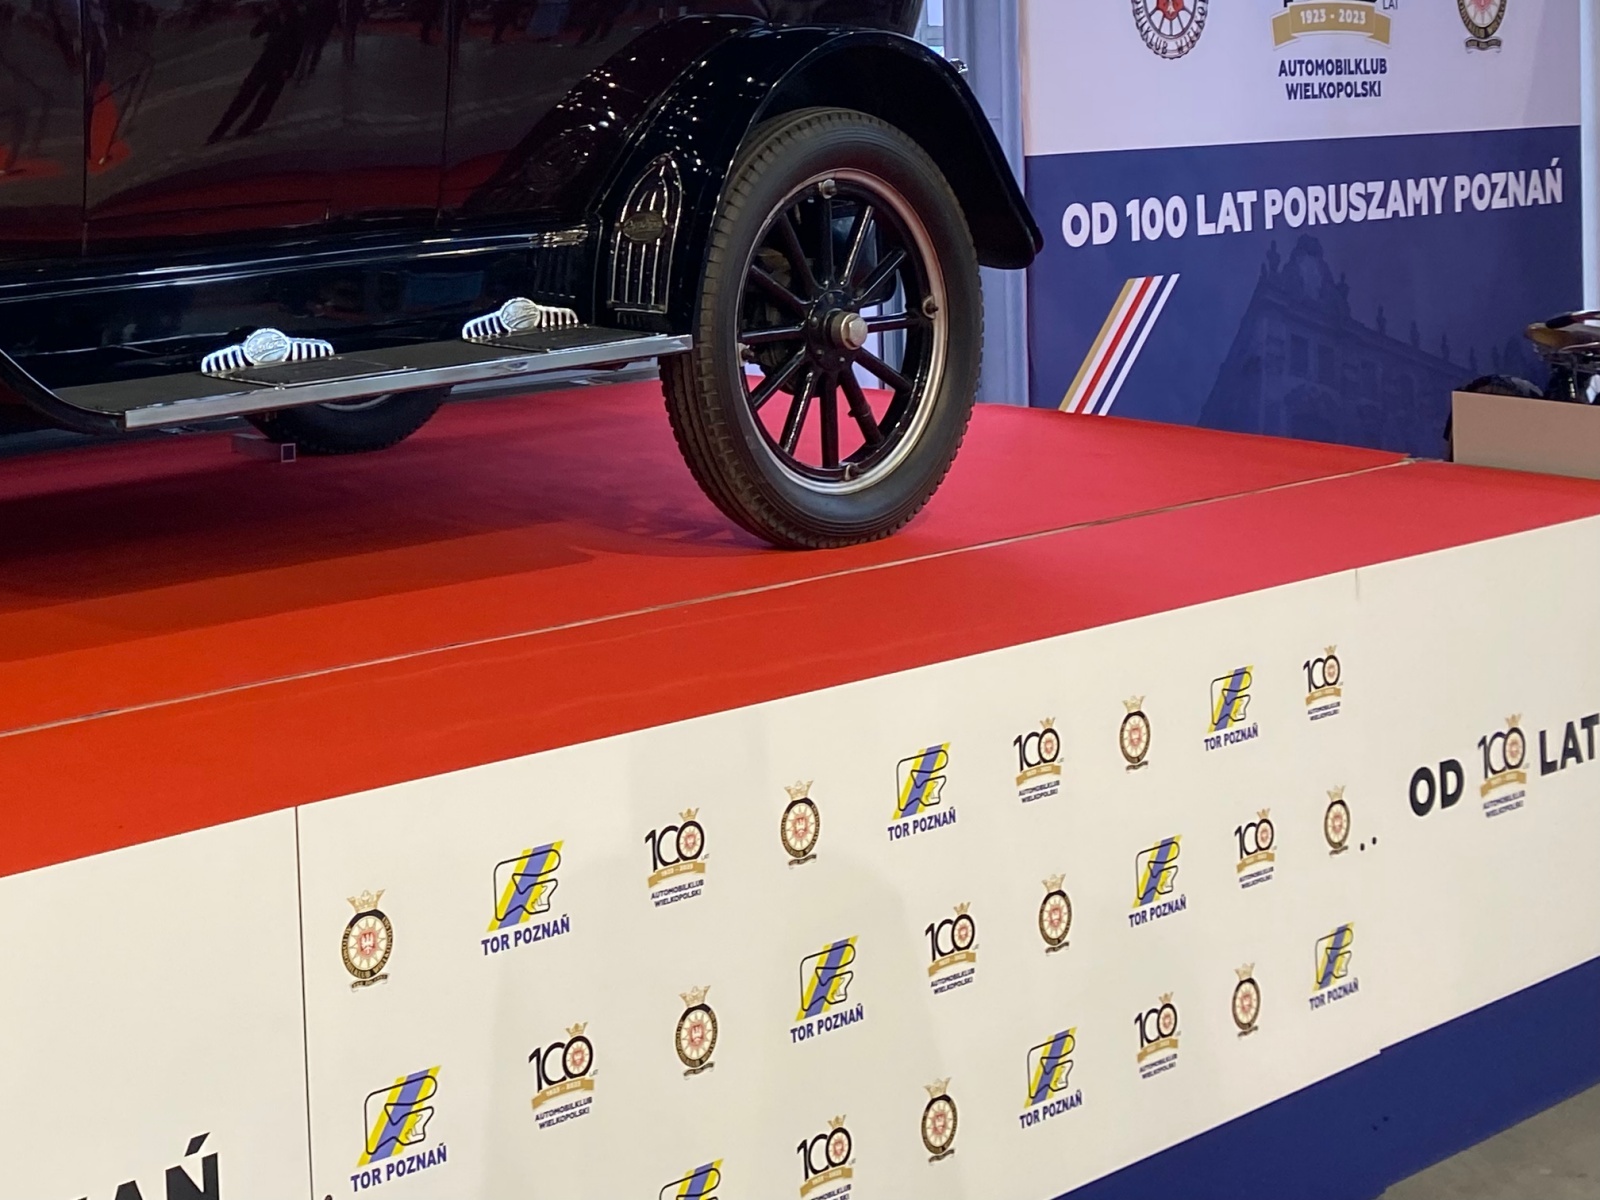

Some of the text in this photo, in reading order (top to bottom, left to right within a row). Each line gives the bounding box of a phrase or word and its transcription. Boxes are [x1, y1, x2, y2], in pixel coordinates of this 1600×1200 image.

[1300, 8, 1326, 25] 1923
[1338, 8, 1367, 25] 2023
[1278, 58, 1388, 77] AUTOMOBILKLUB
[1286, 80, 1382, 100] WIELKOPOLSKI
[1061, 157, 1563, 248] OD 100 LAT PORUSZAMY POZNAŃ
[1204, 735, 1222, 751] TOR
[1409, 758, 1464, 817] OD
[1539, 713, 1600, 776] LAT
[887, 822, 910, 841] TOR
[1128, 910, 1147, 928] TOR
[481, 933, 510, 956] TOR
[790, 1022, 814, 1043] TOR
[1019, 1109, 1040, 1129] TOR
[350, 1168, 382, 1192] TOR
